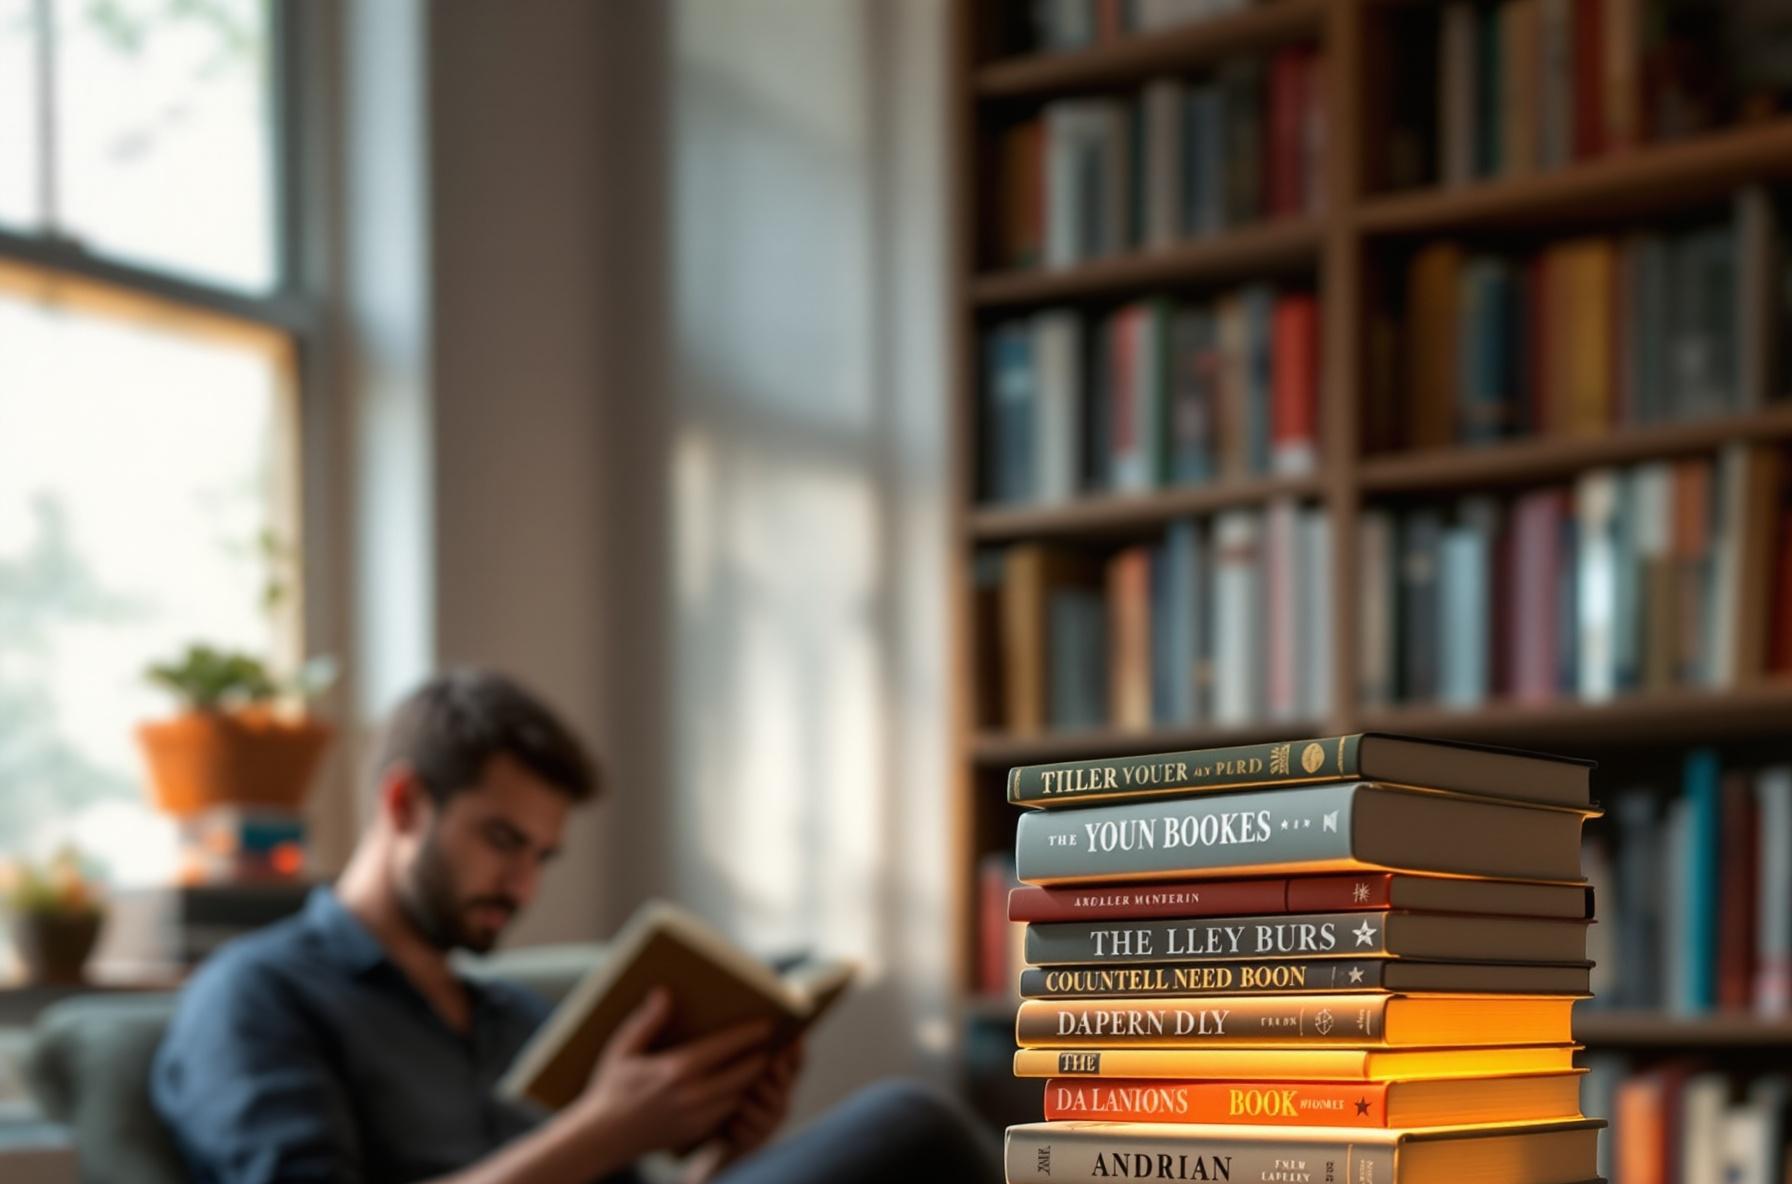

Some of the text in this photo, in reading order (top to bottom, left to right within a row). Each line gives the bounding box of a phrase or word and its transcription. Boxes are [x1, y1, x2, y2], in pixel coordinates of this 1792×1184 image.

[1122, 762, 1188, 784] YOUER
[1049, 810, 1271, 852] THE YOUN BOOKES
[1090, 922, 1336, 956] THE LLEY BURS
[1172, 967, 1232, 990] NEED
[1240, 966, 1307, 987] BOON
[1056, 1010, 1166, 1035] DAPERN
[1061, 1053, 1097, 1072] THE
[1229, 1088, 1299, 1117] BOOK
[1091, 1152, 1232, 1182] ANDRIAN
